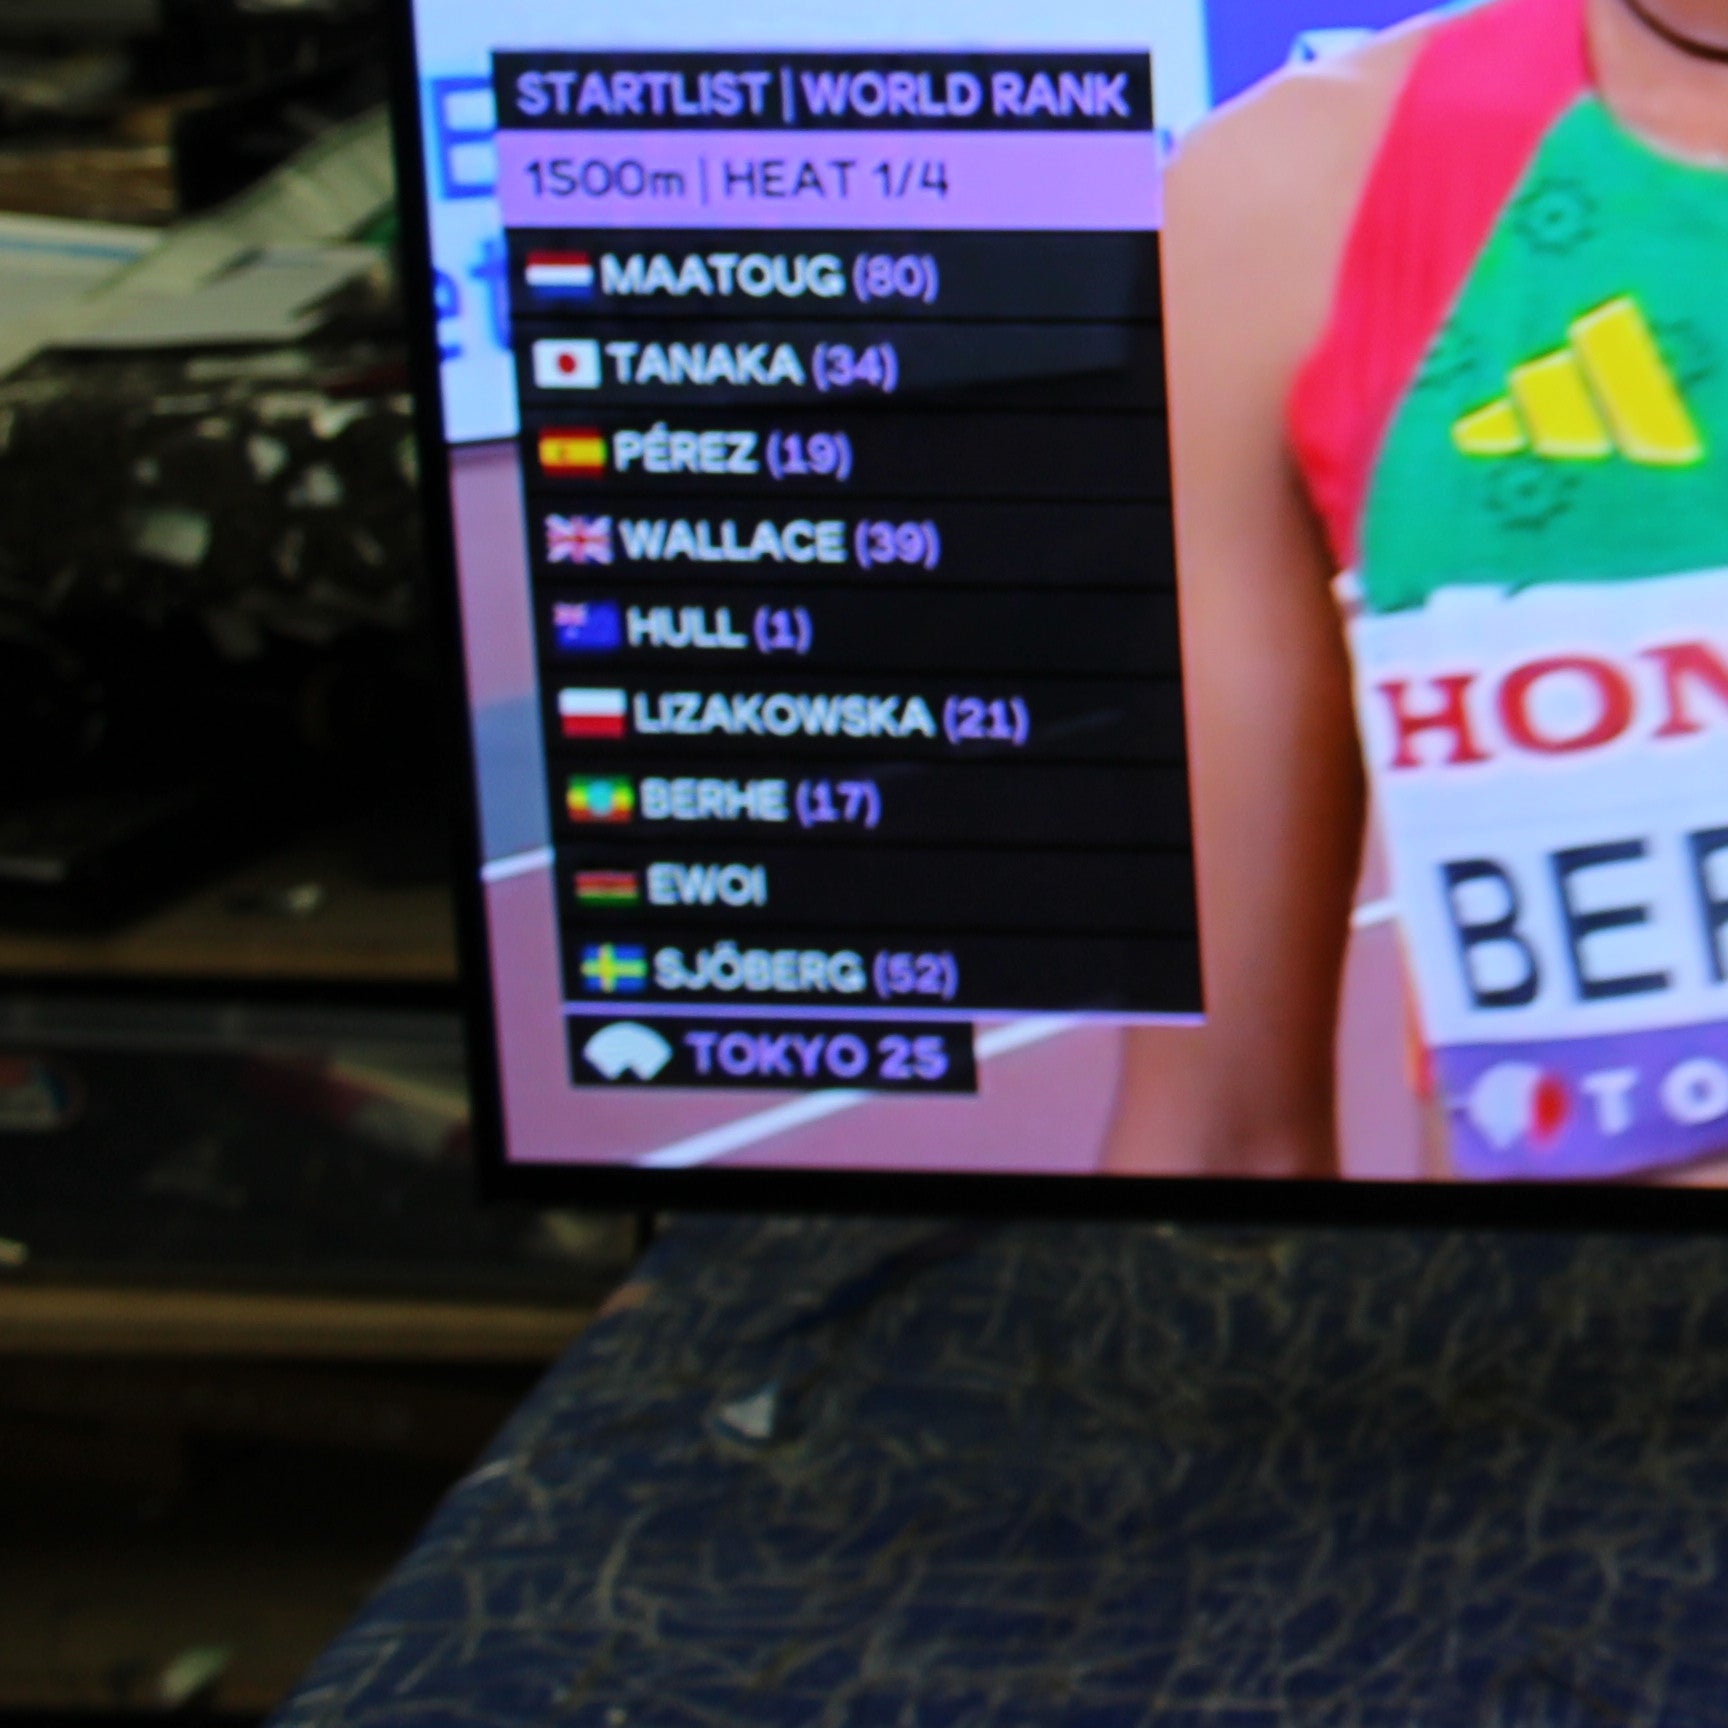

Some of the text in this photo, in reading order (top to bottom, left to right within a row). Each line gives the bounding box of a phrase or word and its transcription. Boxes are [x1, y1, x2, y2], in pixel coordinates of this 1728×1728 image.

[516, 70, 1130, 118] STARTLIST WORLD RANK
[525, 159, 949, 199] 1500m HEAT 1/4
[601, 252, 939, 304] MAATOUG (80)
[606, 341, 898, 392] TANAKA (34)
[613, 419, 852, 480] PÉREZ (19)
[619, 517, 940, 568] WALLACE (39)
[627, 606, 812, 654] HULL (1)
[634, 691, 1030, 747] LIZAKOWSKA (21)
[640, 777, 881, 828] BERHE (17)
[646, 864, 767, 907] EWOI
[654, 940, 958, 1000] SJÖBERG (52)
[686, 1032, 948, 1080] TOKYO 25
